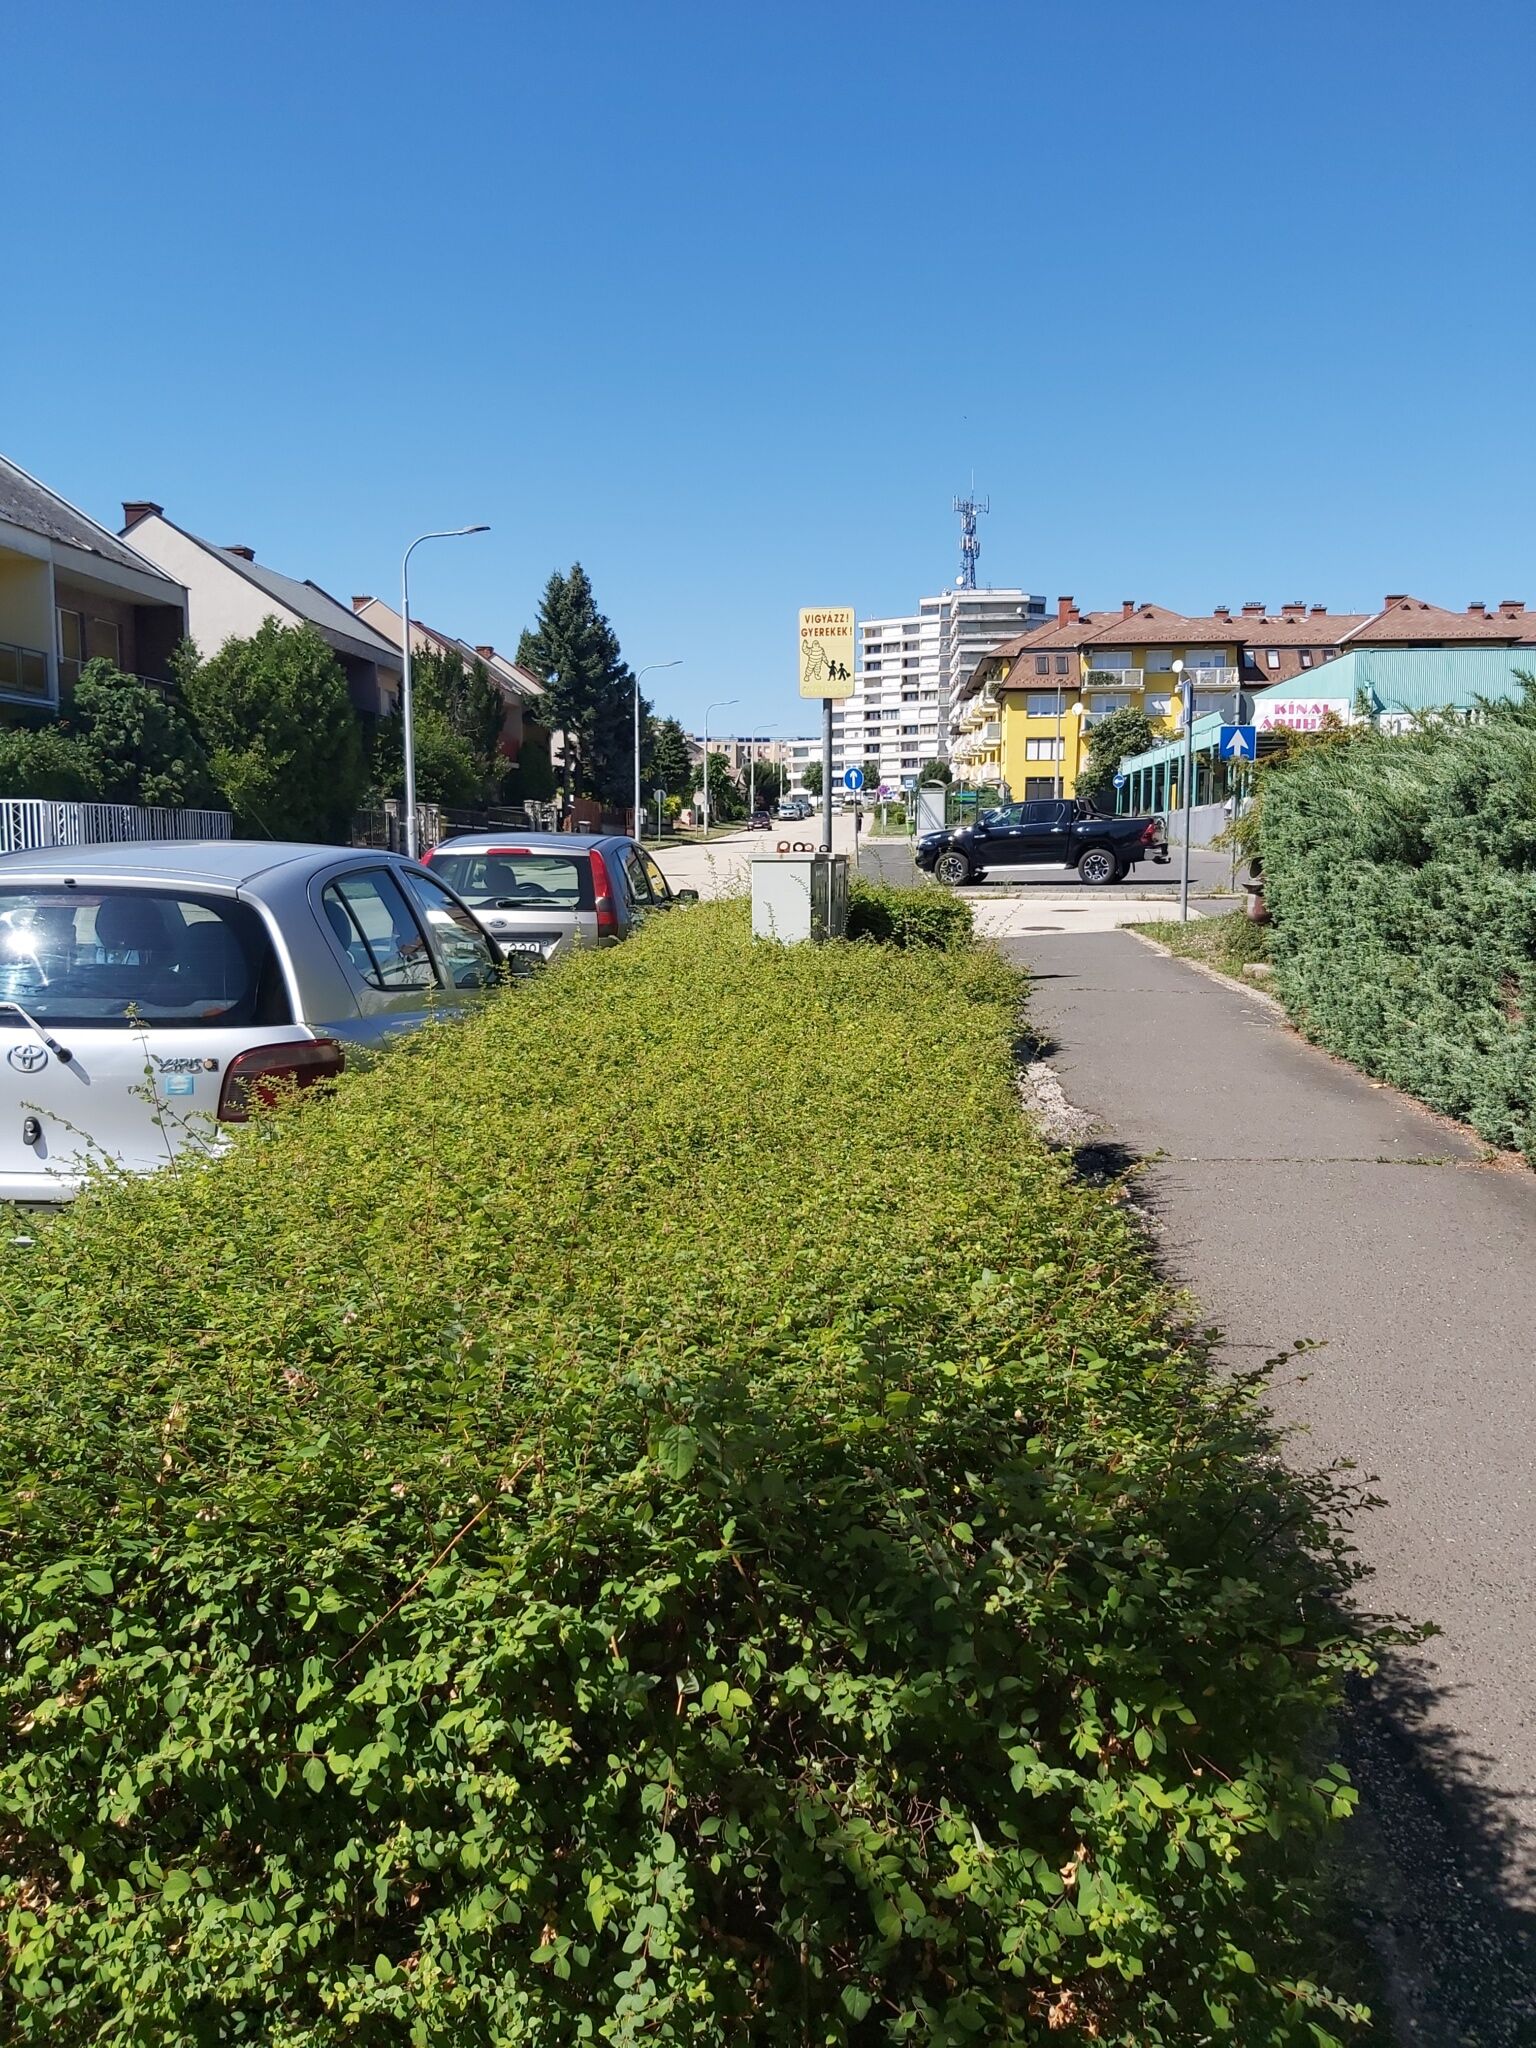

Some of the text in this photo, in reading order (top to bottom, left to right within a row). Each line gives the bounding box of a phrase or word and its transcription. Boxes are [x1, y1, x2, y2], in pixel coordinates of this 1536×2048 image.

[804, 610, 849, 624] VIGYÁZZ!
[800, 626, 853, 638] GYEREKEK!
[1274, 700, 1329, 715] KÍNAI
